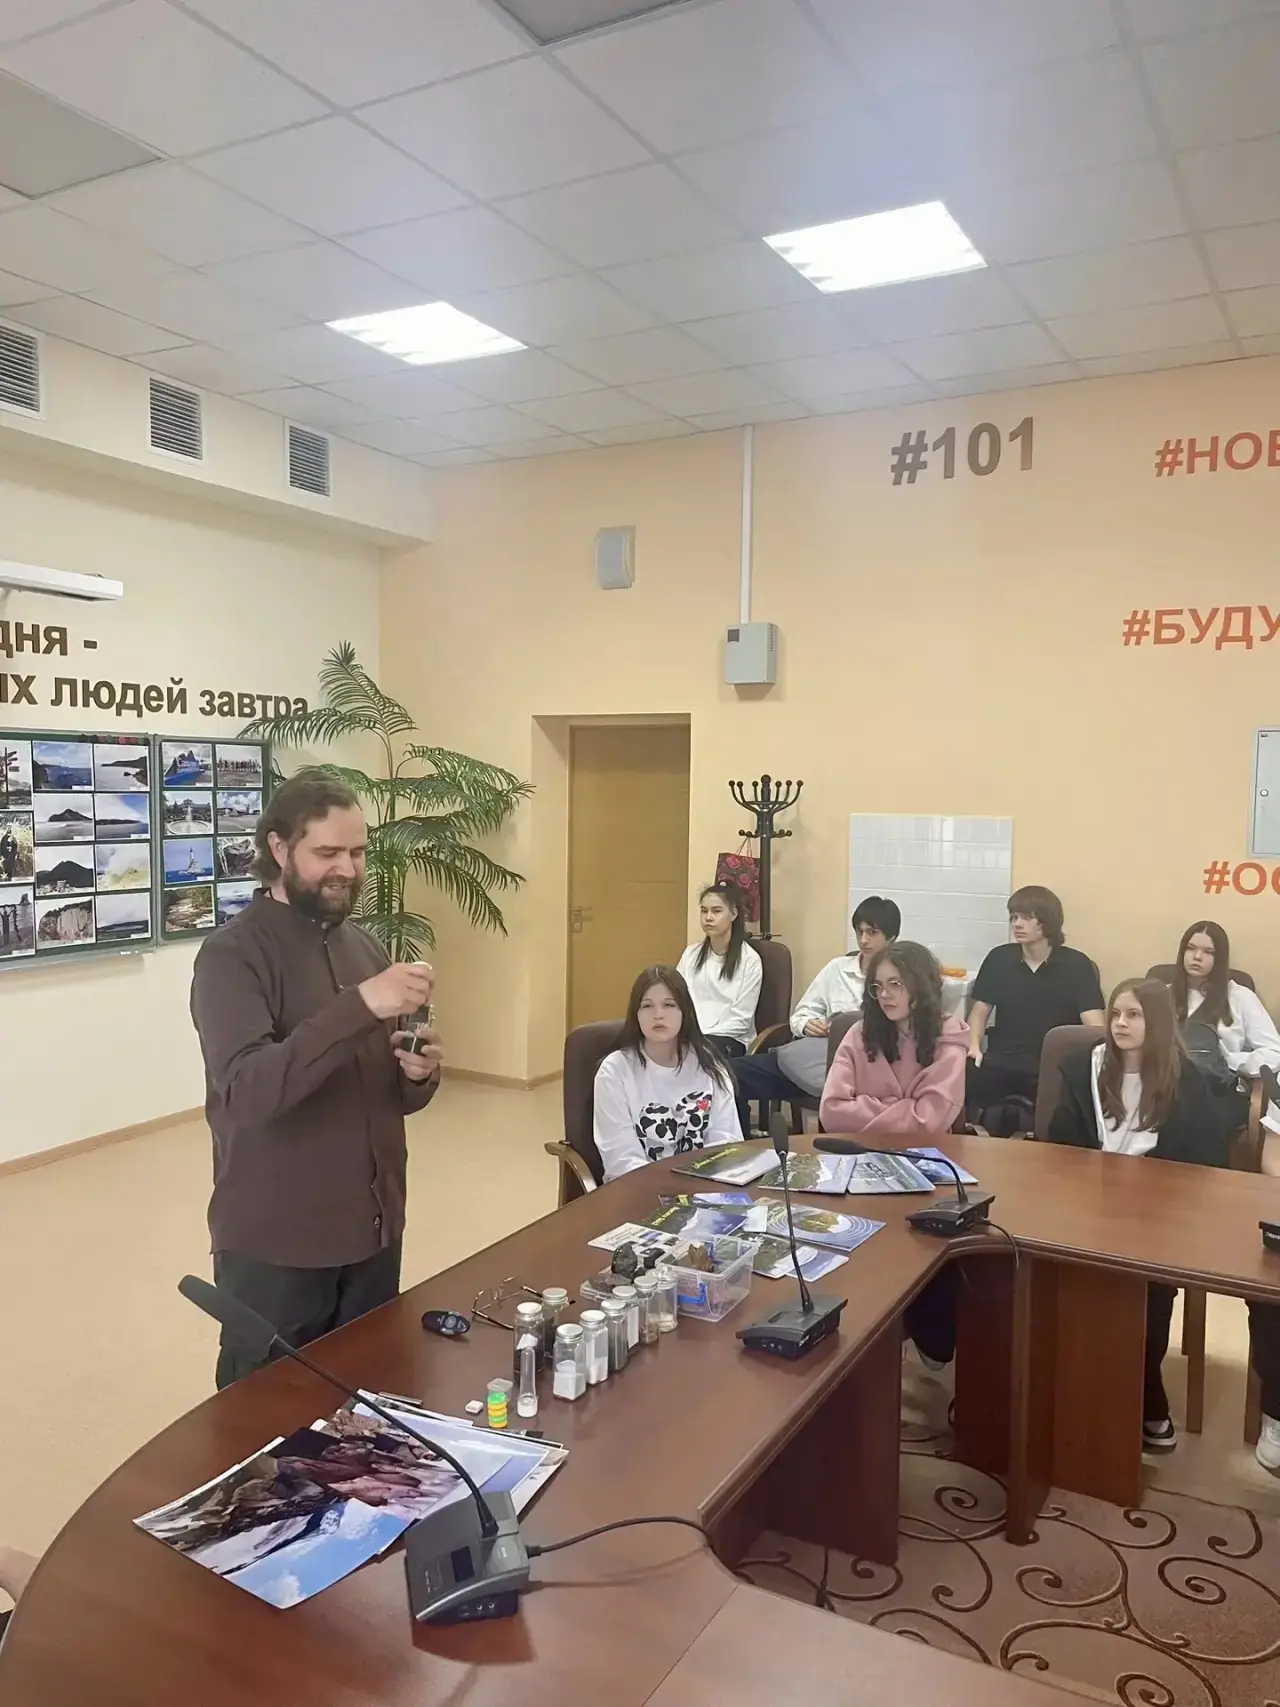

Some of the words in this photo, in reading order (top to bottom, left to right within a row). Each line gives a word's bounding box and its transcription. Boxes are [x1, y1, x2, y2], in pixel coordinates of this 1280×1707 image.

[891, 417, 1033, 485] #101
[1123, 605, 1280, 650] #БУДУ
[0, 673, 38, 705] х
[51, 677, 187, 718] людей
[199, 689, 308, 719] завтра
[1203, 861, 1280, 895] #О
